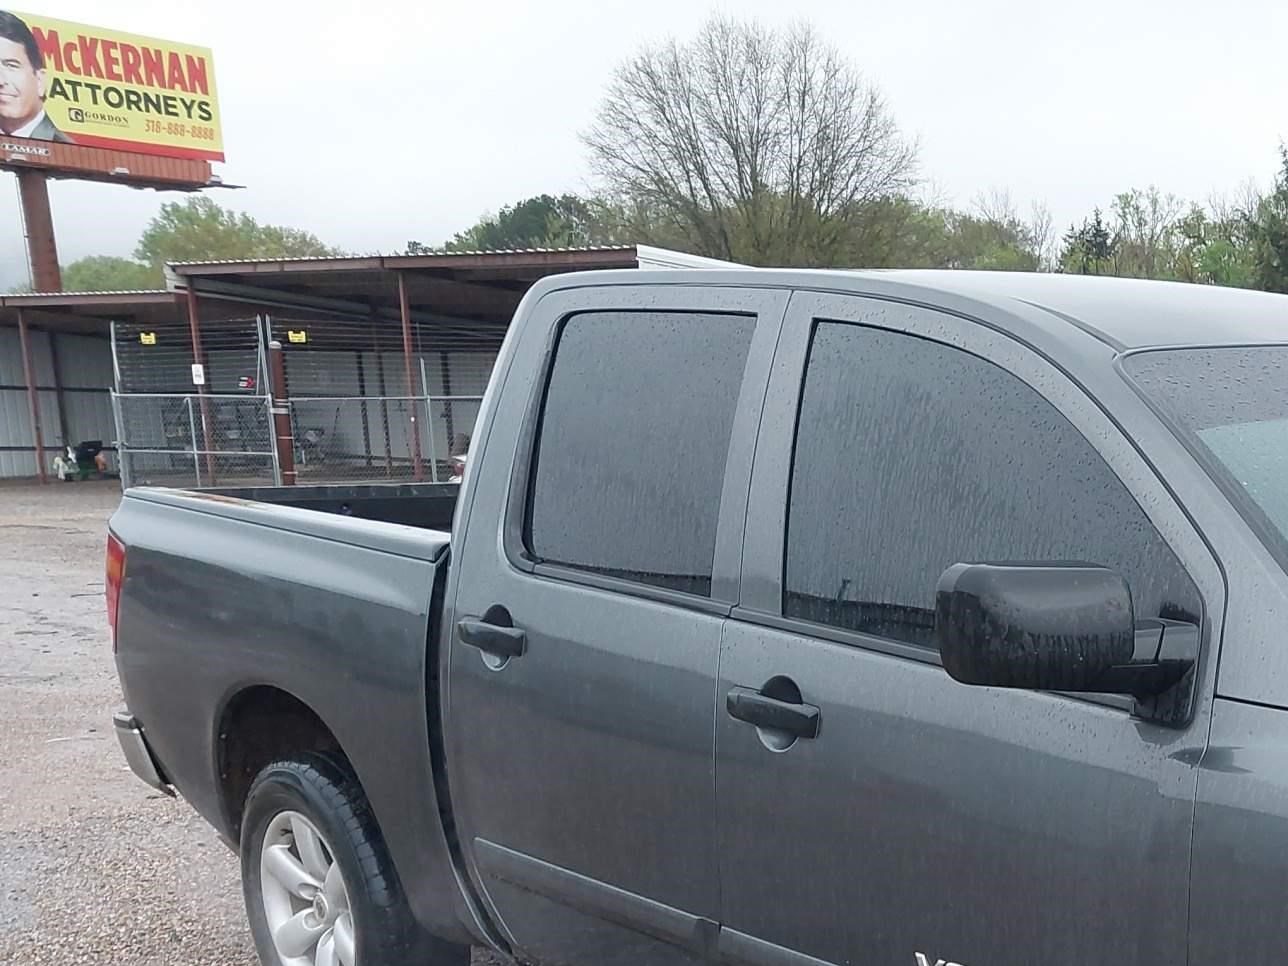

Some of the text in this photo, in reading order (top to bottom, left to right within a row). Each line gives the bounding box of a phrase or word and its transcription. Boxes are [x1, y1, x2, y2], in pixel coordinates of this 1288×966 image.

[49, 77, 213, 122] ATTORNEYS
[85, 111, 129, 124] GORDON
[144, 119, 215, 141] 318-888-8888
